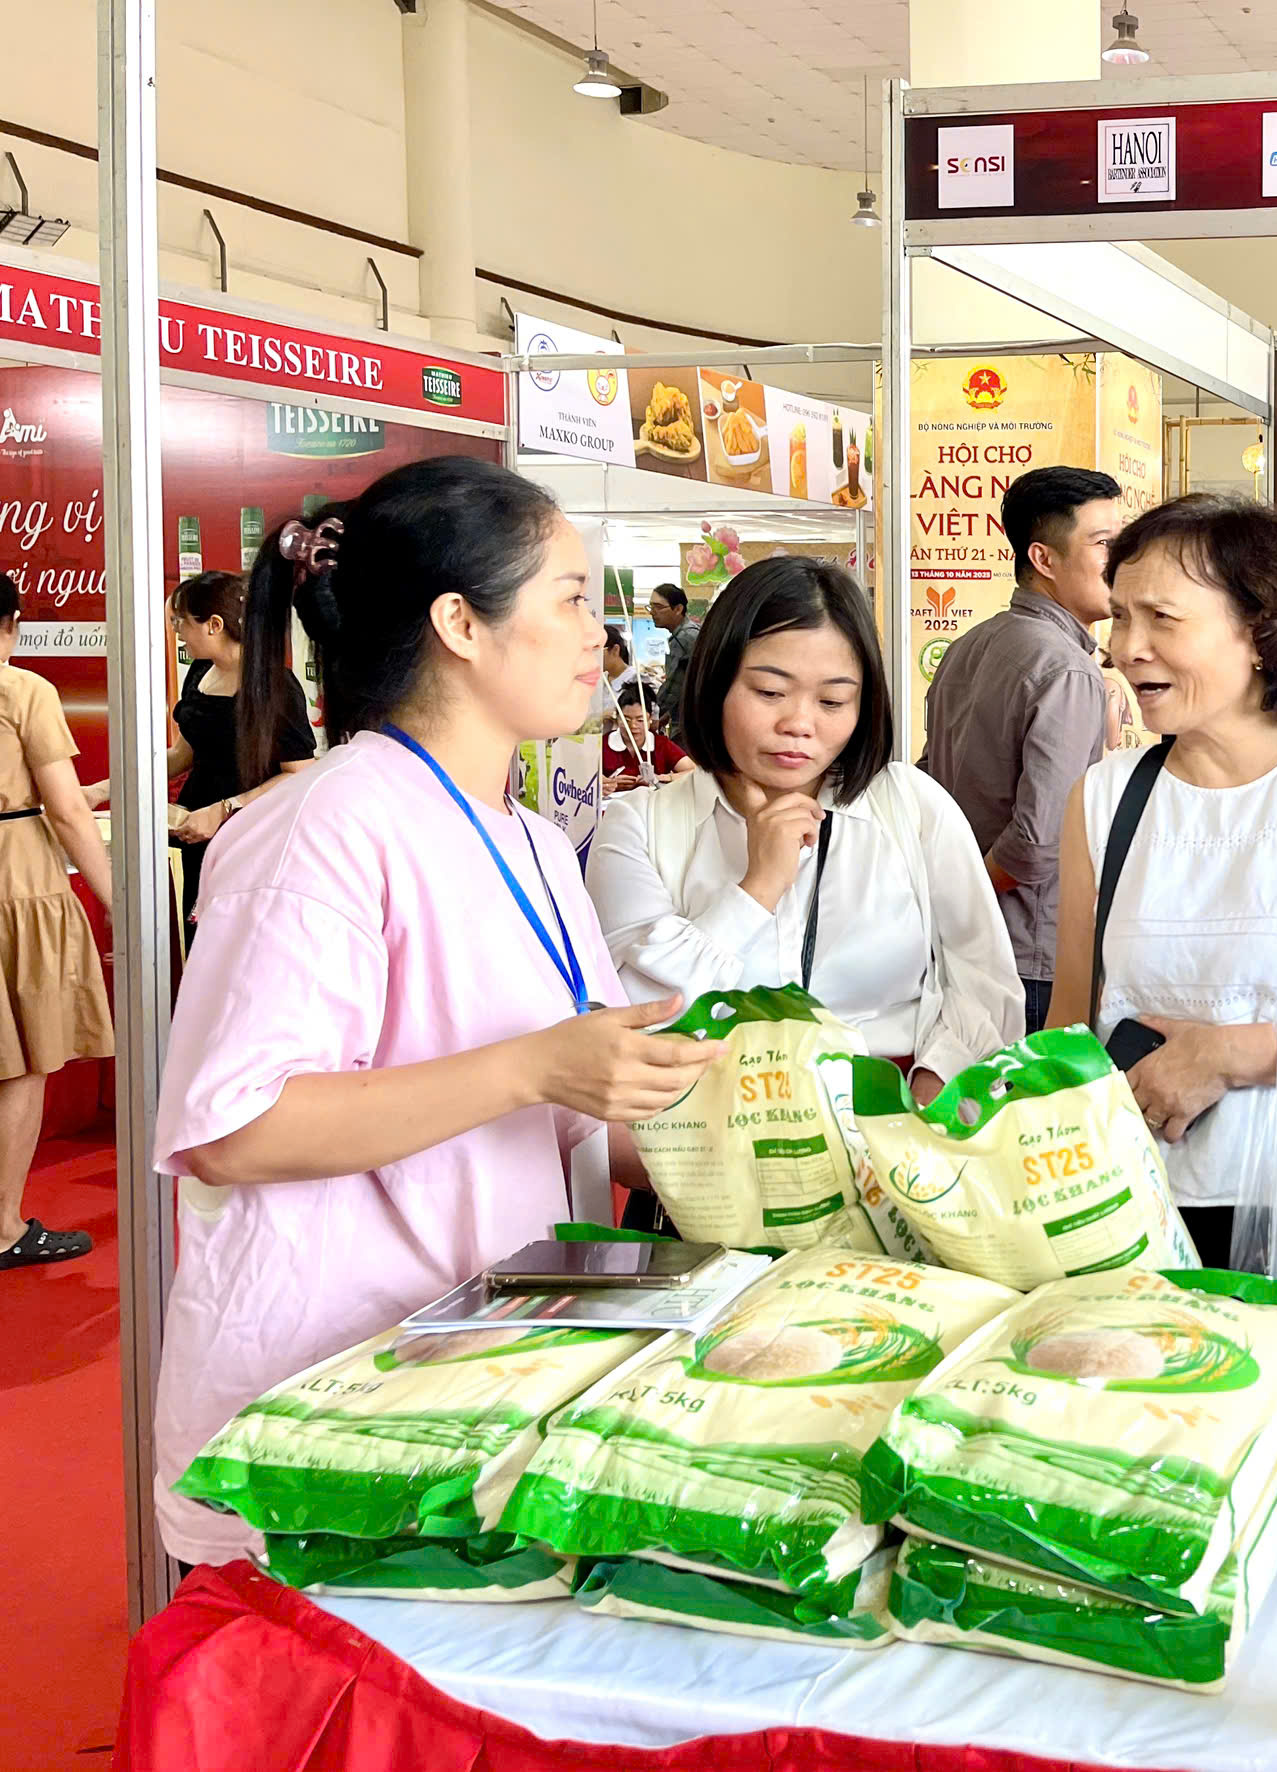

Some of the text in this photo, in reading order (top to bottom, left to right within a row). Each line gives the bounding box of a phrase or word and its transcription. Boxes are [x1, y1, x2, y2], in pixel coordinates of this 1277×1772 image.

[1112, 131, 1162, 166] HANOI
[1107, 167, 1167, 181] BARTENDER ASSOCIATION
[197, 323, 384, 391] TEISSEIRE
[423, 375, 461, 398] TEISSEIRE
[539, 424, 615, 452] MAXKO GROUP
[937, 442, 1033, 467] HỘI CHỢ
[910, 469, 983, 499] ÀNG
[63, 488, 103, 543] vị
[916, 507, 979, 542] VIỆT
[935, 546, 969, 561] THỨ
[971, 548, 985, 561] 21
[920, 569, 945, 579] THÁNG
[910, 608, 974, 618] RAFT VIET
[924, 619, 958, 632] 2025
[18, 628, 49, 650] mọi
[552, 766, 594, 808] Cowhead
[554, 809, 569, 826] PURE
[1023, 1141, 1094, 1186] ST25
[825, 1261, 926, 1291] ST25
